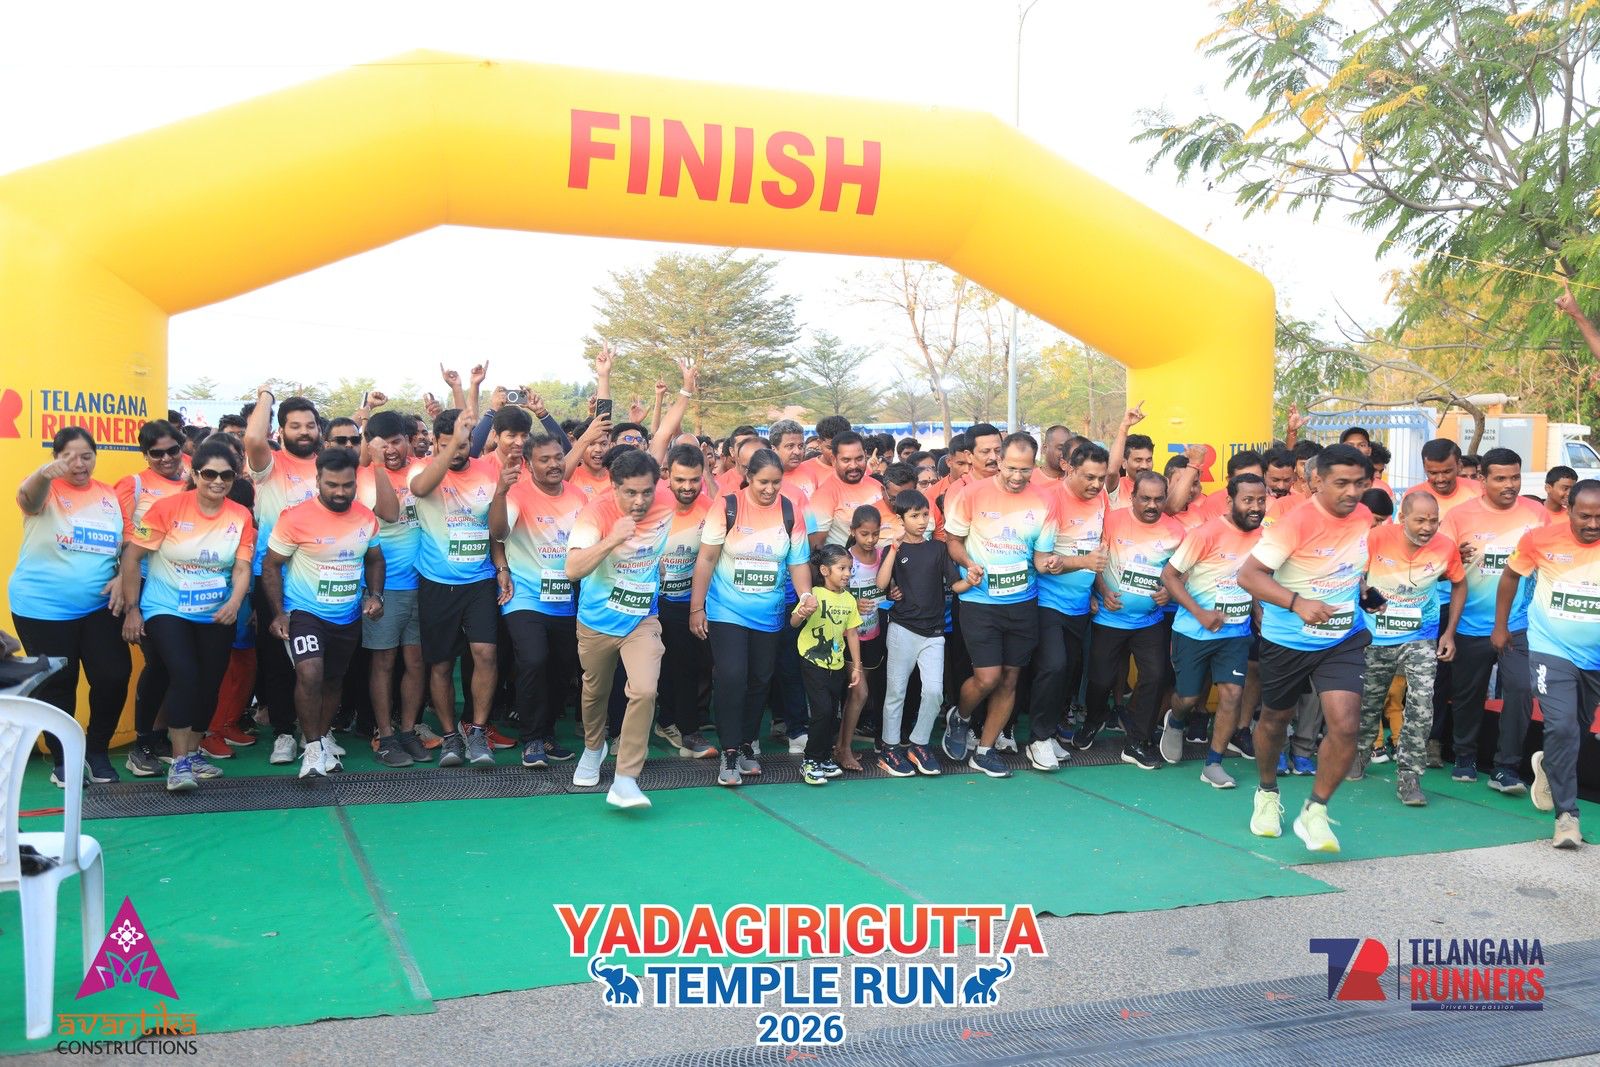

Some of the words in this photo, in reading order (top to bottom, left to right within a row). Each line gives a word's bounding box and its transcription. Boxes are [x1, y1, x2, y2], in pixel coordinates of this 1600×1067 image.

[567, 108, 882, 216] FINISH
[40, 389, 148, 418] TELANGANA
[87, 531, 115, 543] 10302
[461, 543, 487, 551] 50397
[747, 573, 775, 583] 50155
[1000, 573, 1026, 584] 50154
[332, 583, 357, 592] 50399
[194, 591, 224, 601] 10301
[624, 594, 651, 604] 50176
[1226, 604, 1250, 614] 50007
[1566, 598, 1600, 610] 50179
[1322, 616, 1353, 626] 0005
[1389, 619, 1420, 628] 50097
[293, 634, 320, 655] 08
